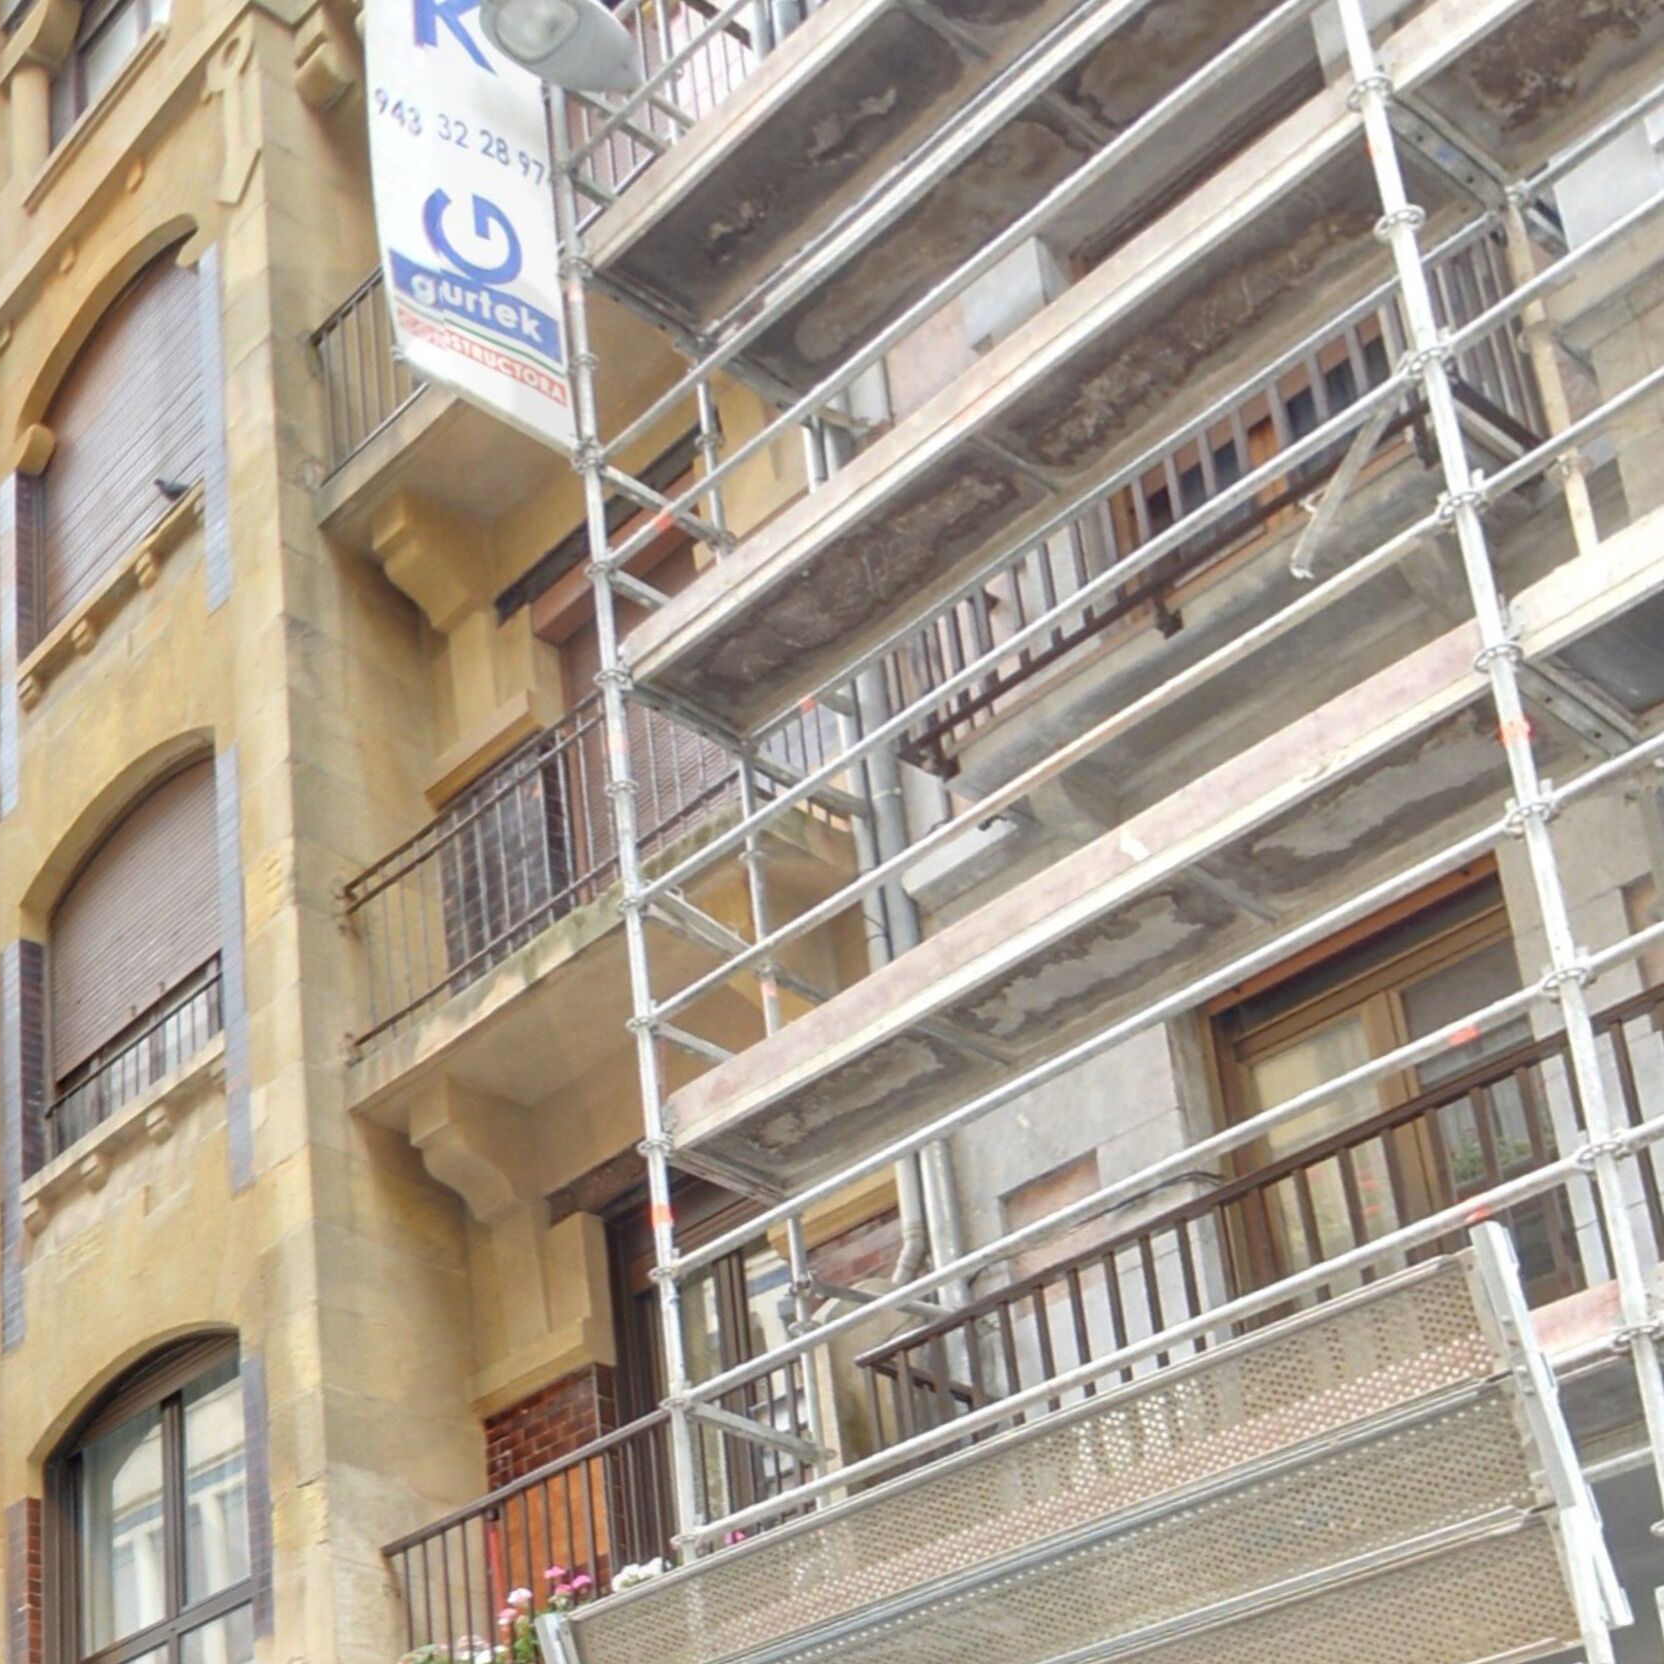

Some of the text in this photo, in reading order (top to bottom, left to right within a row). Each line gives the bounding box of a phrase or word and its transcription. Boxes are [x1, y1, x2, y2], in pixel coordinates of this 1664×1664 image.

[438, 113, 470, 149] 32
[479, 129, 511, 167] 28
[518, 151, 546, 186] 97
[410, 272, 543, 344] gurtek
[397, 306, 567, 406] STRUCTORA
